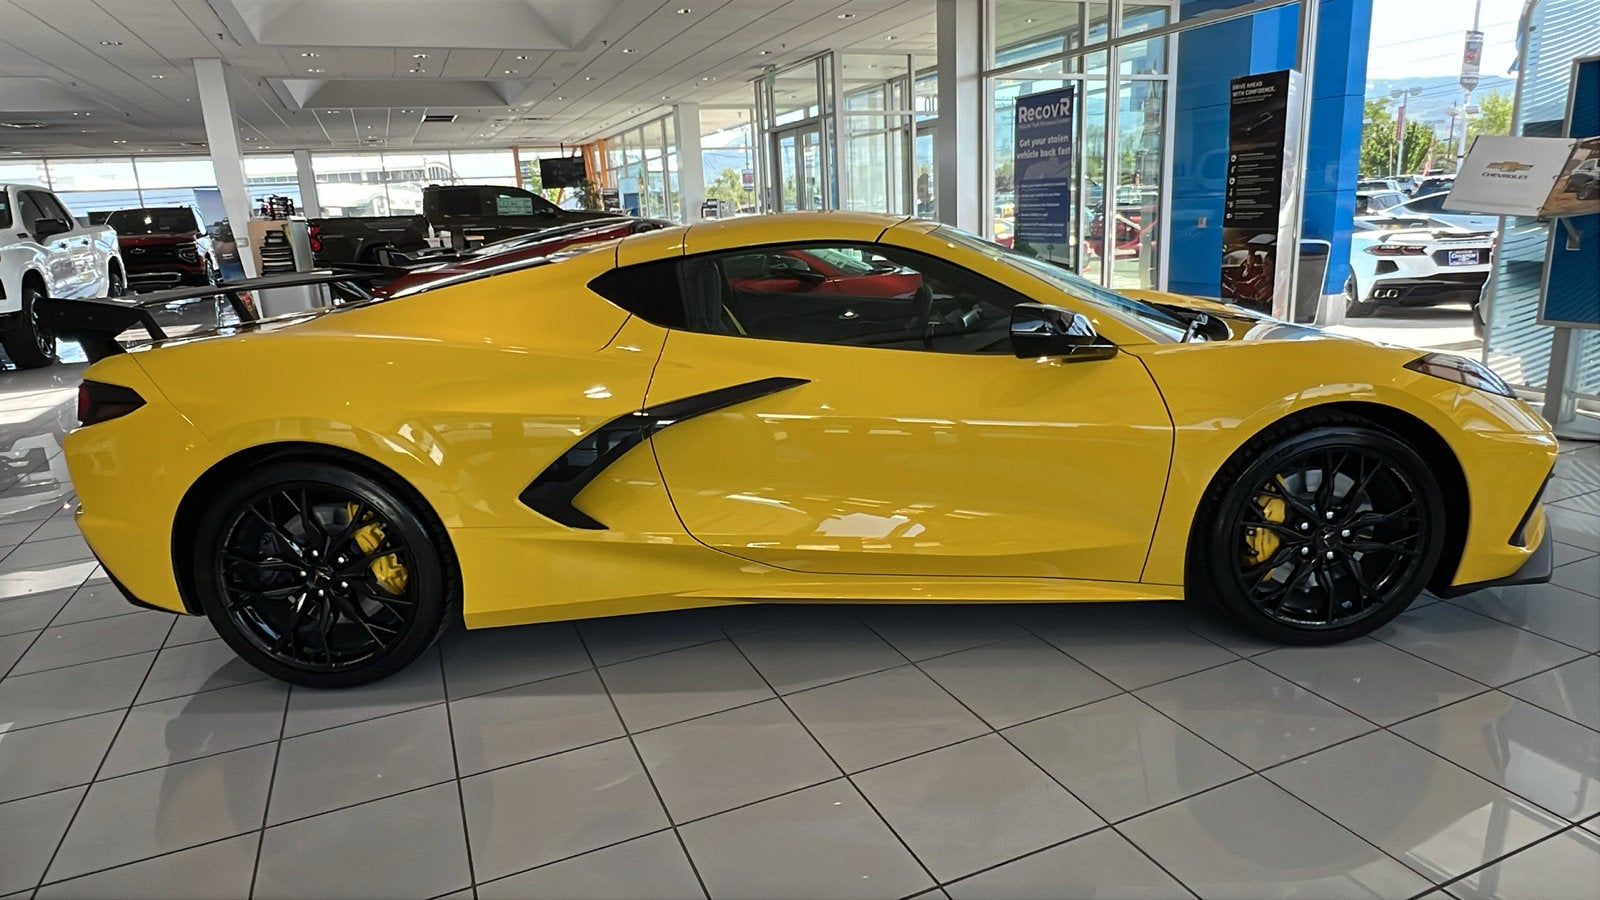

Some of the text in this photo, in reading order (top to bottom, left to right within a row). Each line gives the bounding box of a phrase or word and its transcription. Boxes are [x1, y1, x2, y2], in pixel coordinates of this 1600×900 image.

[1232, 81, 1263, 91] DRIVE AHEAD
[1019, 97, 1070, 123] RecovR
[1020, 134, 1069, 148] Get your stolen
[1017, 146, 1071, 159] vehicle back fast
[1482, 172, 1529, 180] CHEVROLET
